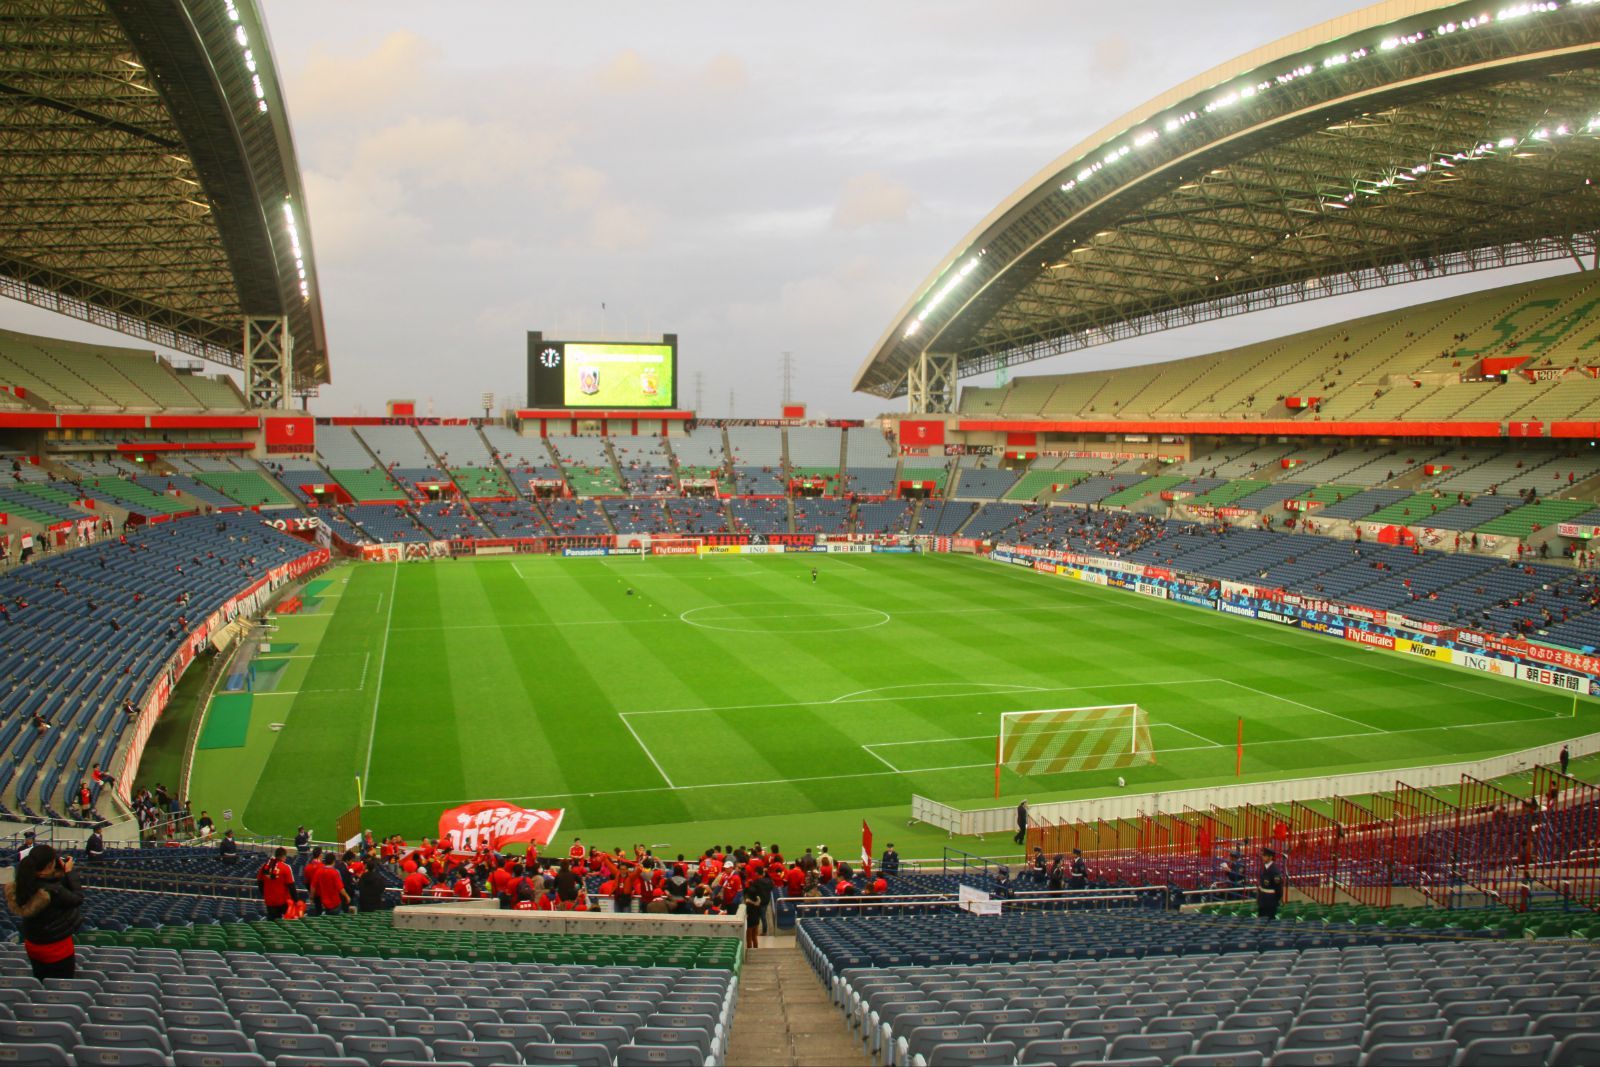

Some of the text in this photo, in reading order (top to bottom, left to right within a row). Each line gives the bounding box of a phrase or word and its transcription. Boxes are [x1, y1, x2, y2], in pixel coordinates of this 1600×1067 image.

[565, 548, 605, 557] Panasonic
[1221, 602, 1255, 617] Panasonic
[1301, 619, 1344, 637] the-AFC.com
[1348, 628, 1393, 648] Fly Emirates
[1410, 643, 1436, 658] Nikon
[1463, 655, 1487, 670] ING
[1526, 667, 1580, 690] 朝日新聞
